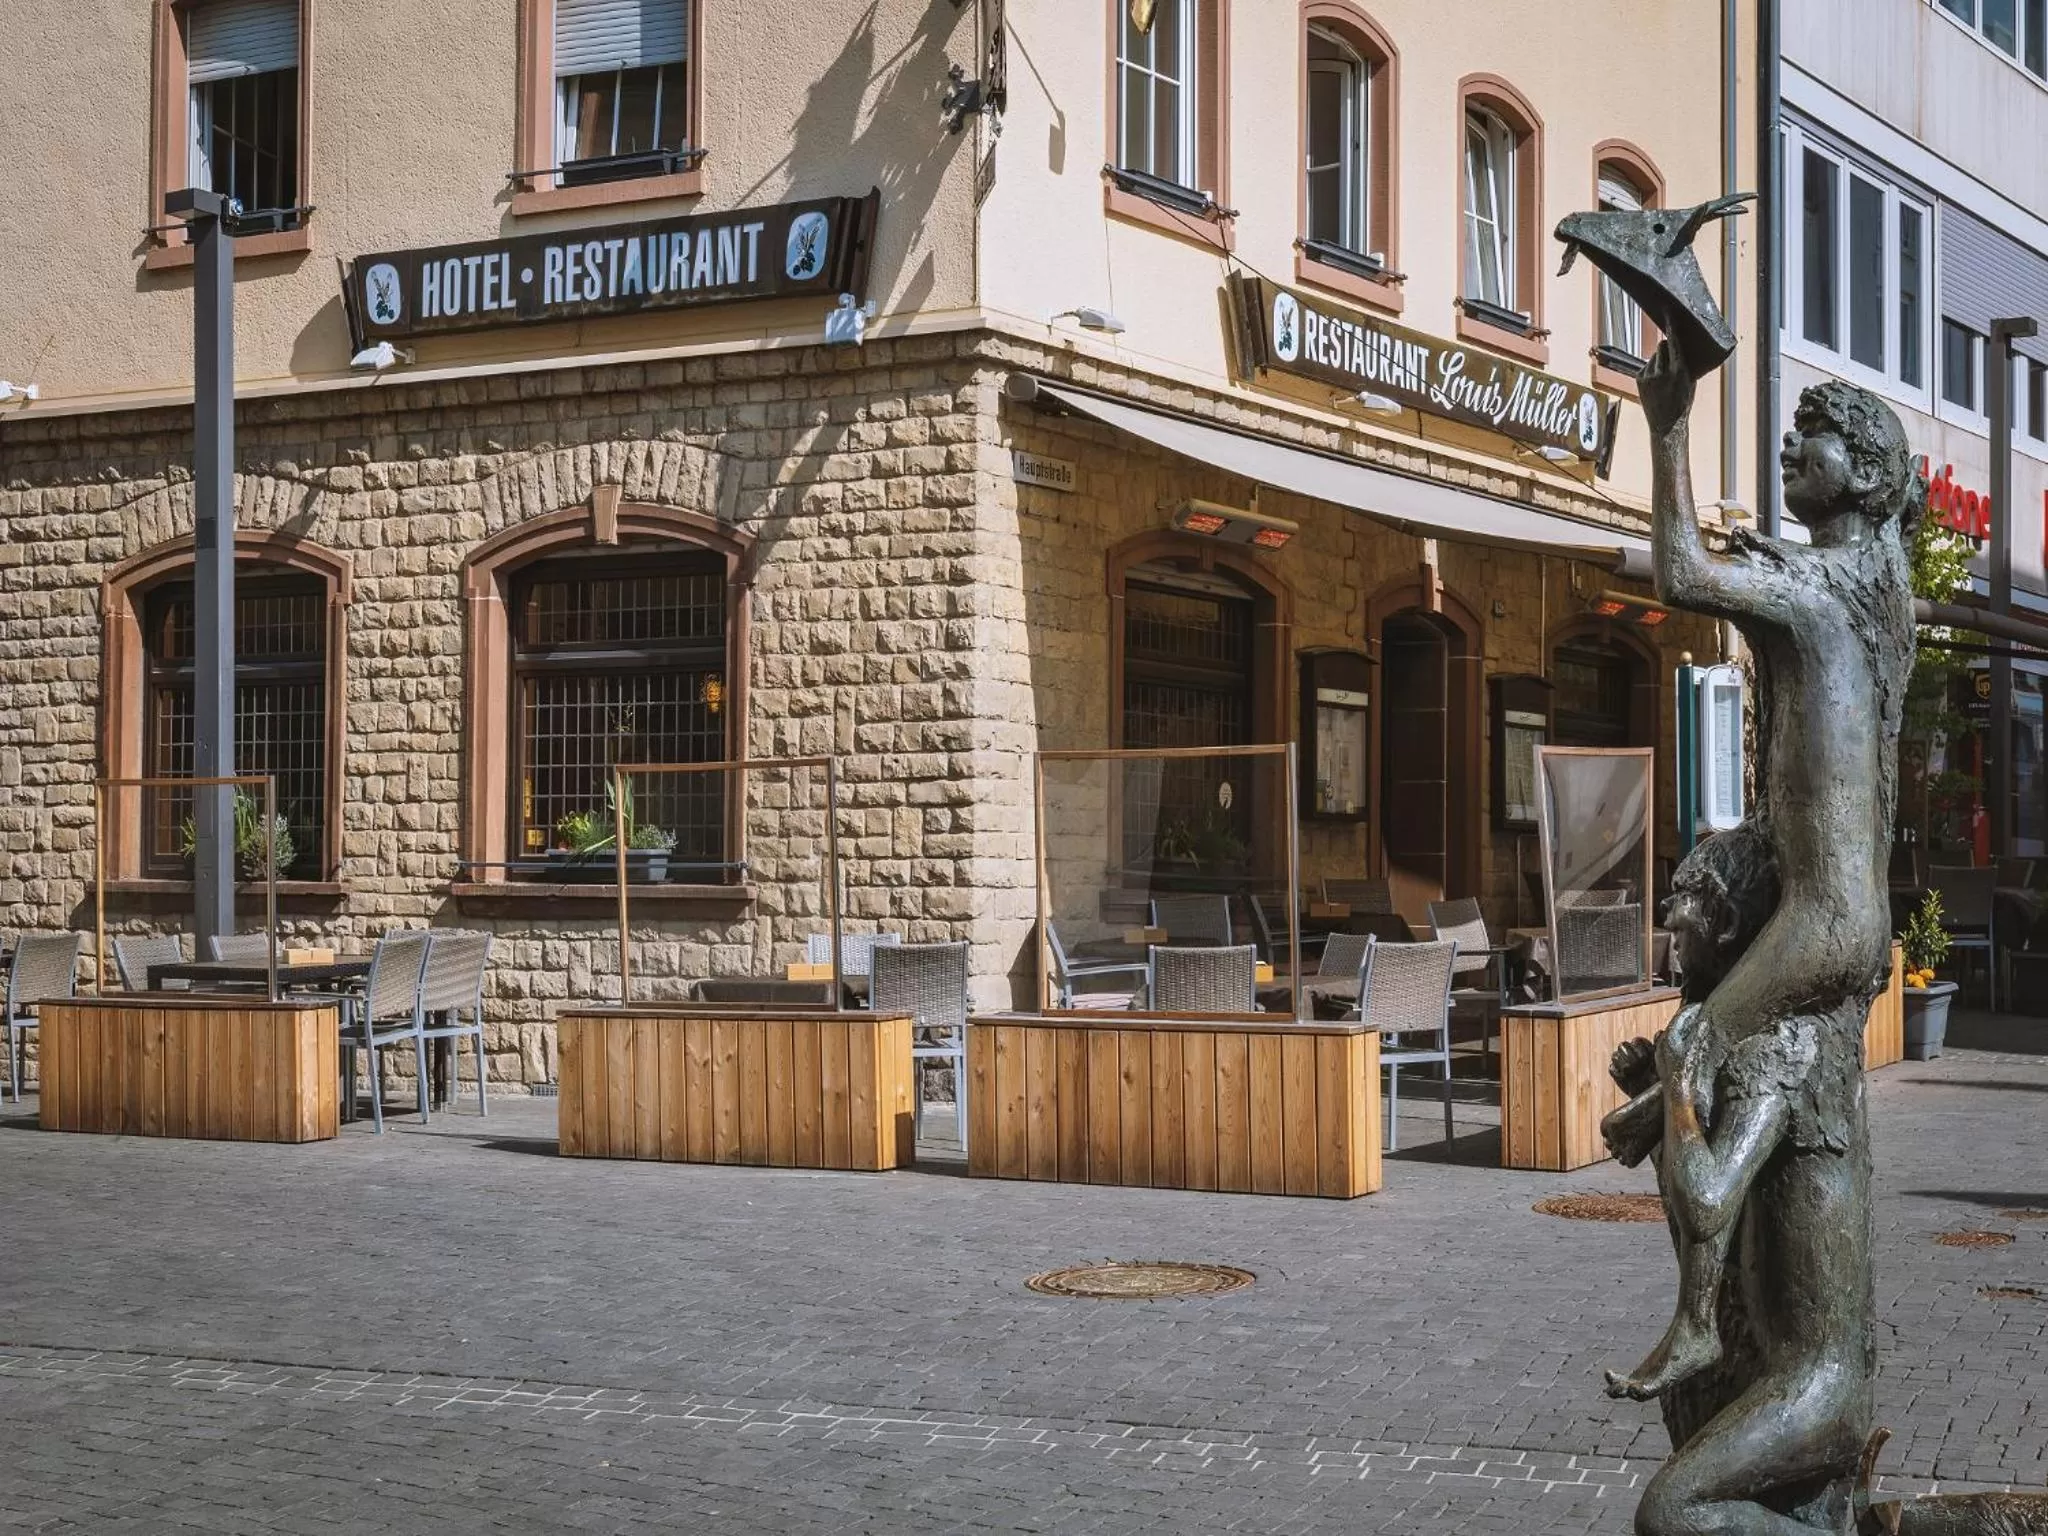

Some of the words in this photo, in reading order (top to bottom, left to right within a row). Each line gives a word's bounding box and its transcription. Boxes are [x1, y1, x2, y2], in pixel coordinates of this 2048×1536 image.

[420, 252, 516, 318] HOTEL
[543, 221, 765, 305] RESTAURANT
[1304, 309, 1430, 395] RESTAURANT
[1429, 350, 1502, 416] Louis
[1492, 371, 1579, 437] Müller
